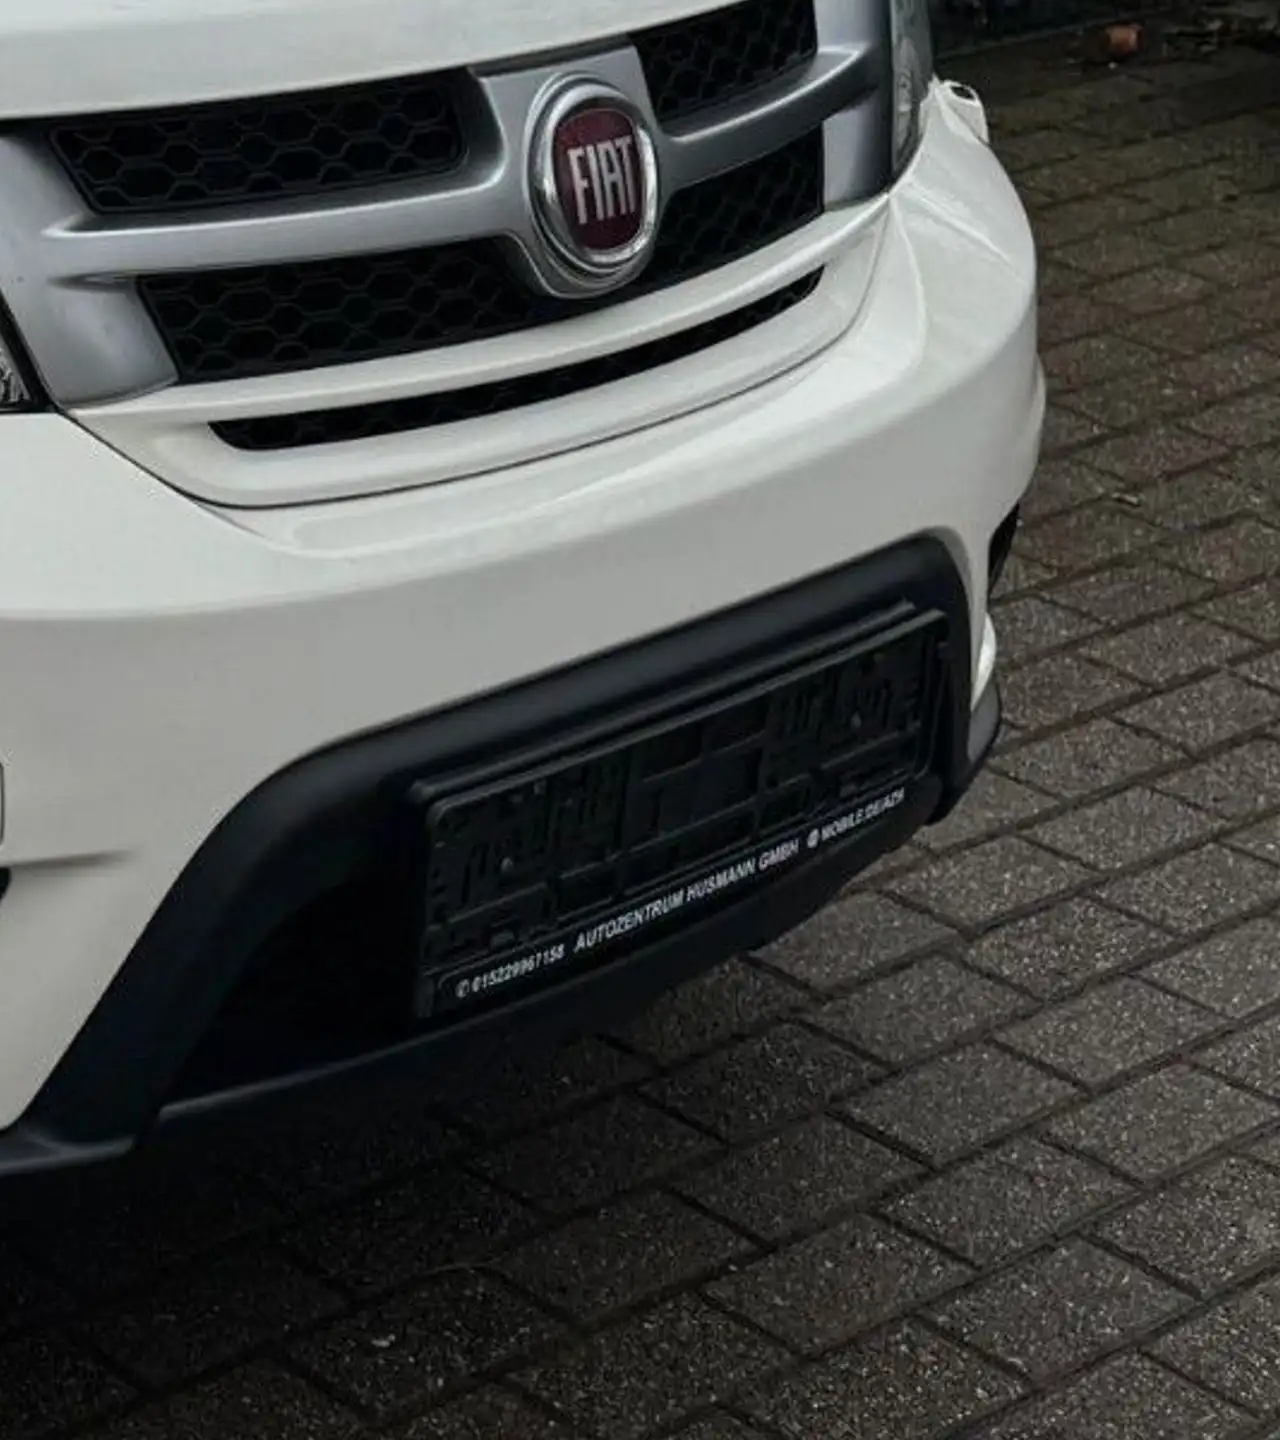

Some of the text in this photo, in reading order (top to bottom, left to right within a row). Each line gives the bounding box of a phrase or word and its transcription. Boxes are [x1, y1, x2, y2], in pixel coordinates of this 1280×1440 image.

[567, 134, 637, 225] FIAT
[573, 887, 685, 953] AUTOZENTRUM
[686, 857, 756, 902] HUSMANN
